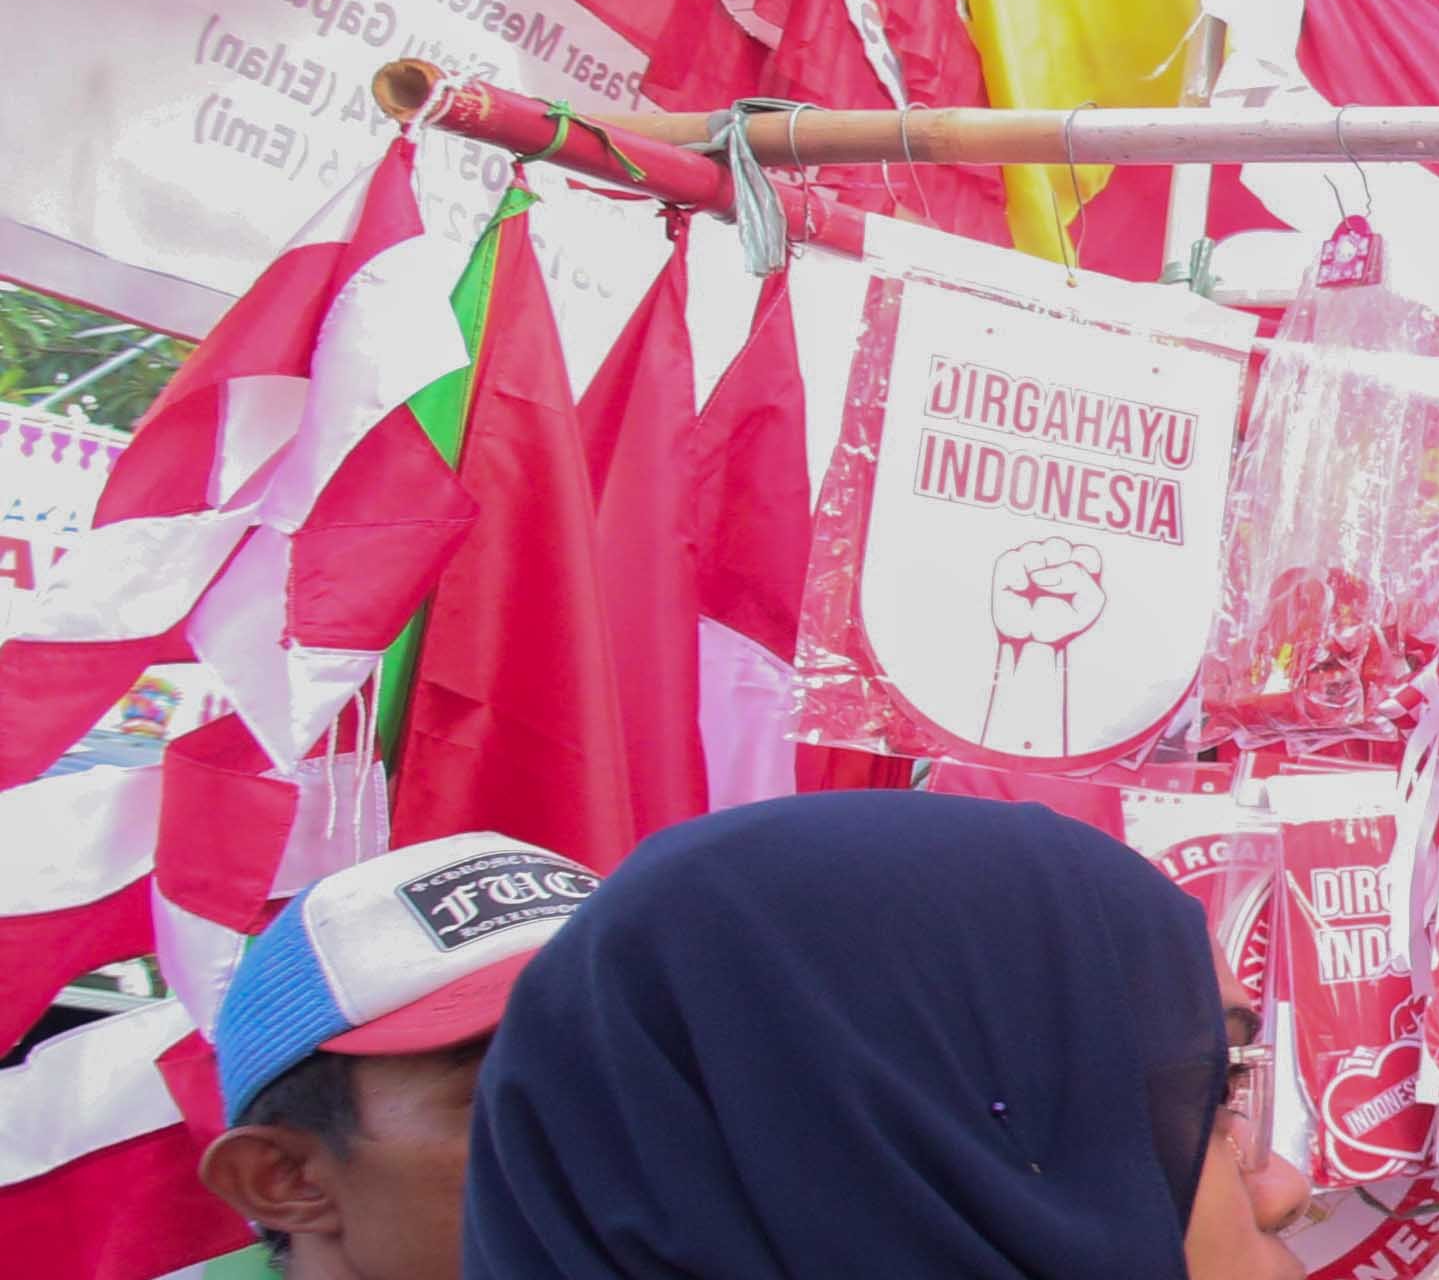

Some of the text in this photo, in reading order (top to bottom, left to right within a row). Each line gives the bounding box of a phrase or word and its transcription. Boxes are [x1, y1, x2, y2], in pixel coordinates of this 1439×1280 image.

[928, 359, 1198, 469] DIRGAHAYU
[919, 433, 1183, 542] INDONESIA
[430, 870, 600, 937] FUC
